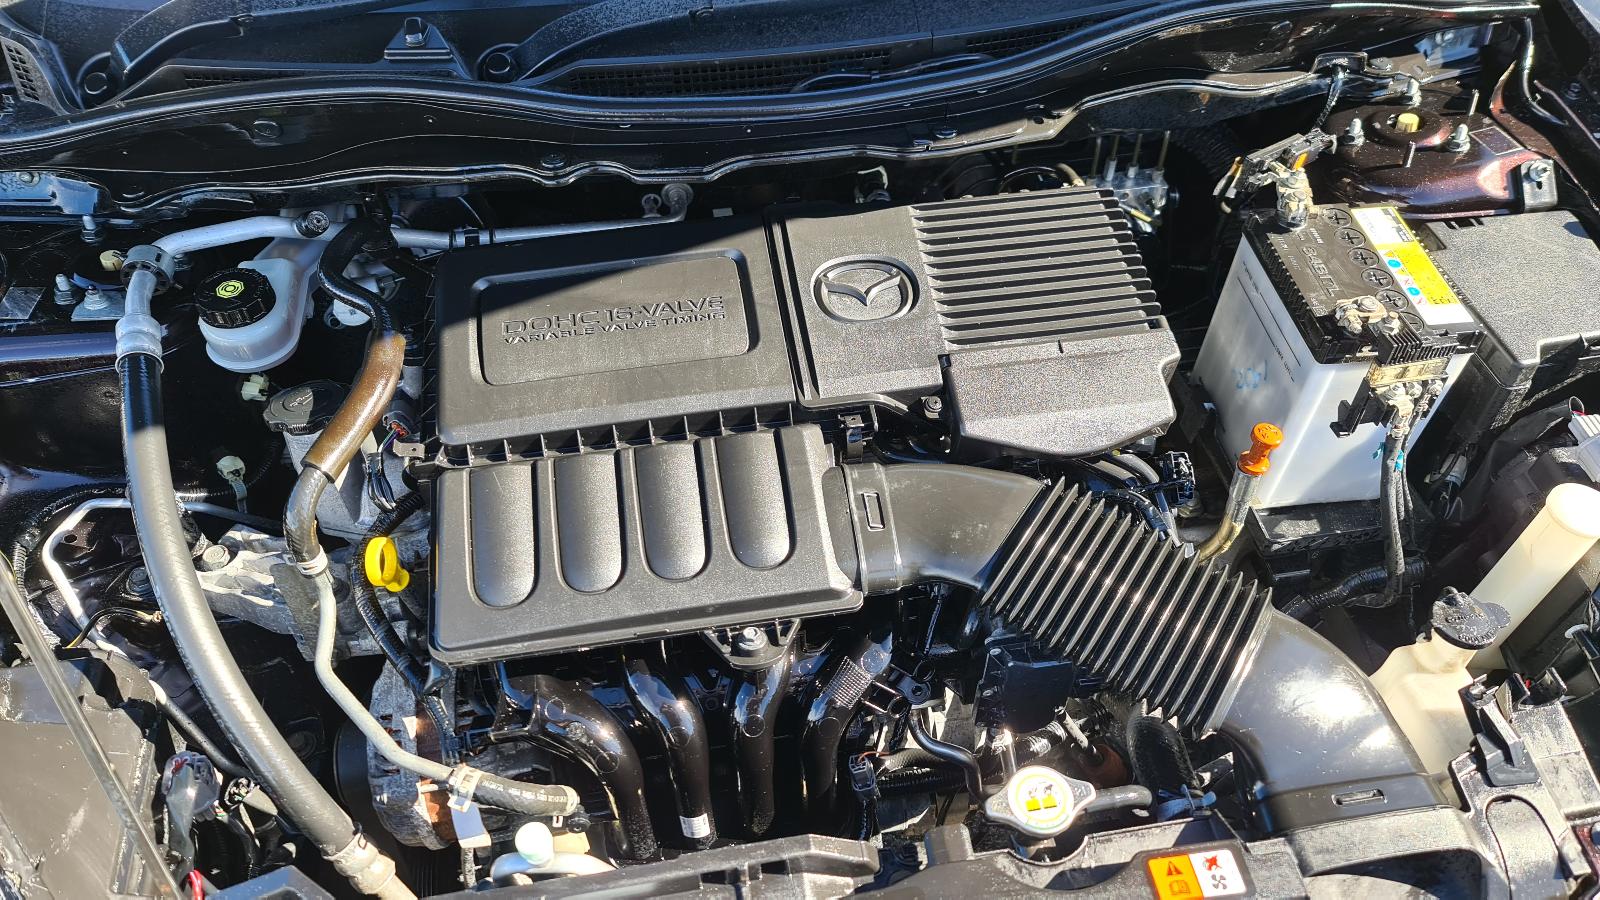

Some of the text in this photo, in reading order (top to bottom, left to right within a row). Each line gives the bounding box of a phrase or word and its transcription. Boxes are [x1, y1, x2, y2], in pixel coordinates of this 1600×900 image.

[501, 296, 724, 336] DOHC 16-VALVE
[504, 312, 725, 345] VARIABLE VALVE TIMING
